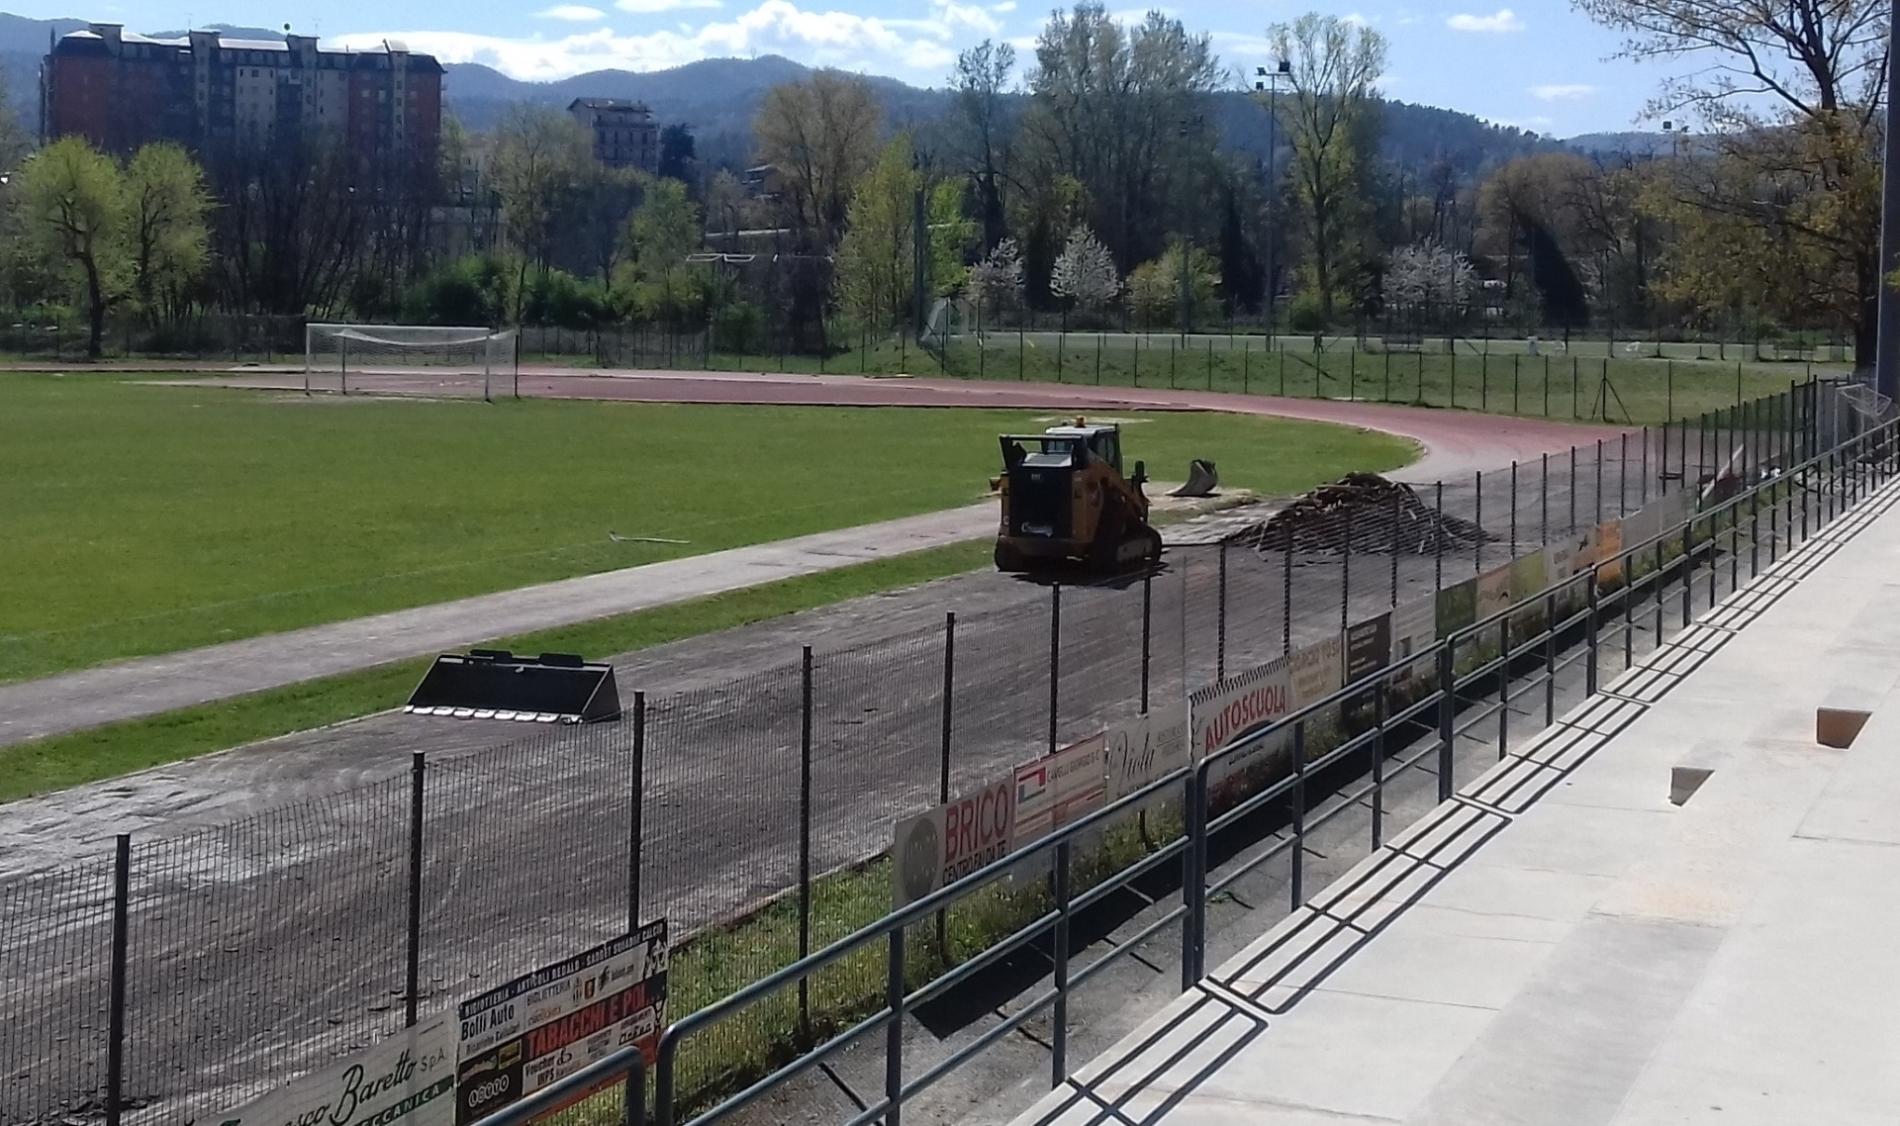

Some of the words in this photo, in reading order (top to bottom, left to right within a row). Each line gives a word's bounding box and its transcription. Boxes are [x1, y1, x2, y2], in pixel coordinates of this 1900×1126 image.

[1205, 685, 1286, 756] AUTOSCUOLA
[945, 784, 1009, 863] BRICO
[461, 1012, 487, 1042] Bolli
[490, 1003, 514, 1029] Auto
[527, 1001, 605, 1059] TABACCHI
[329, 1048, 418, 1126] Baretto
